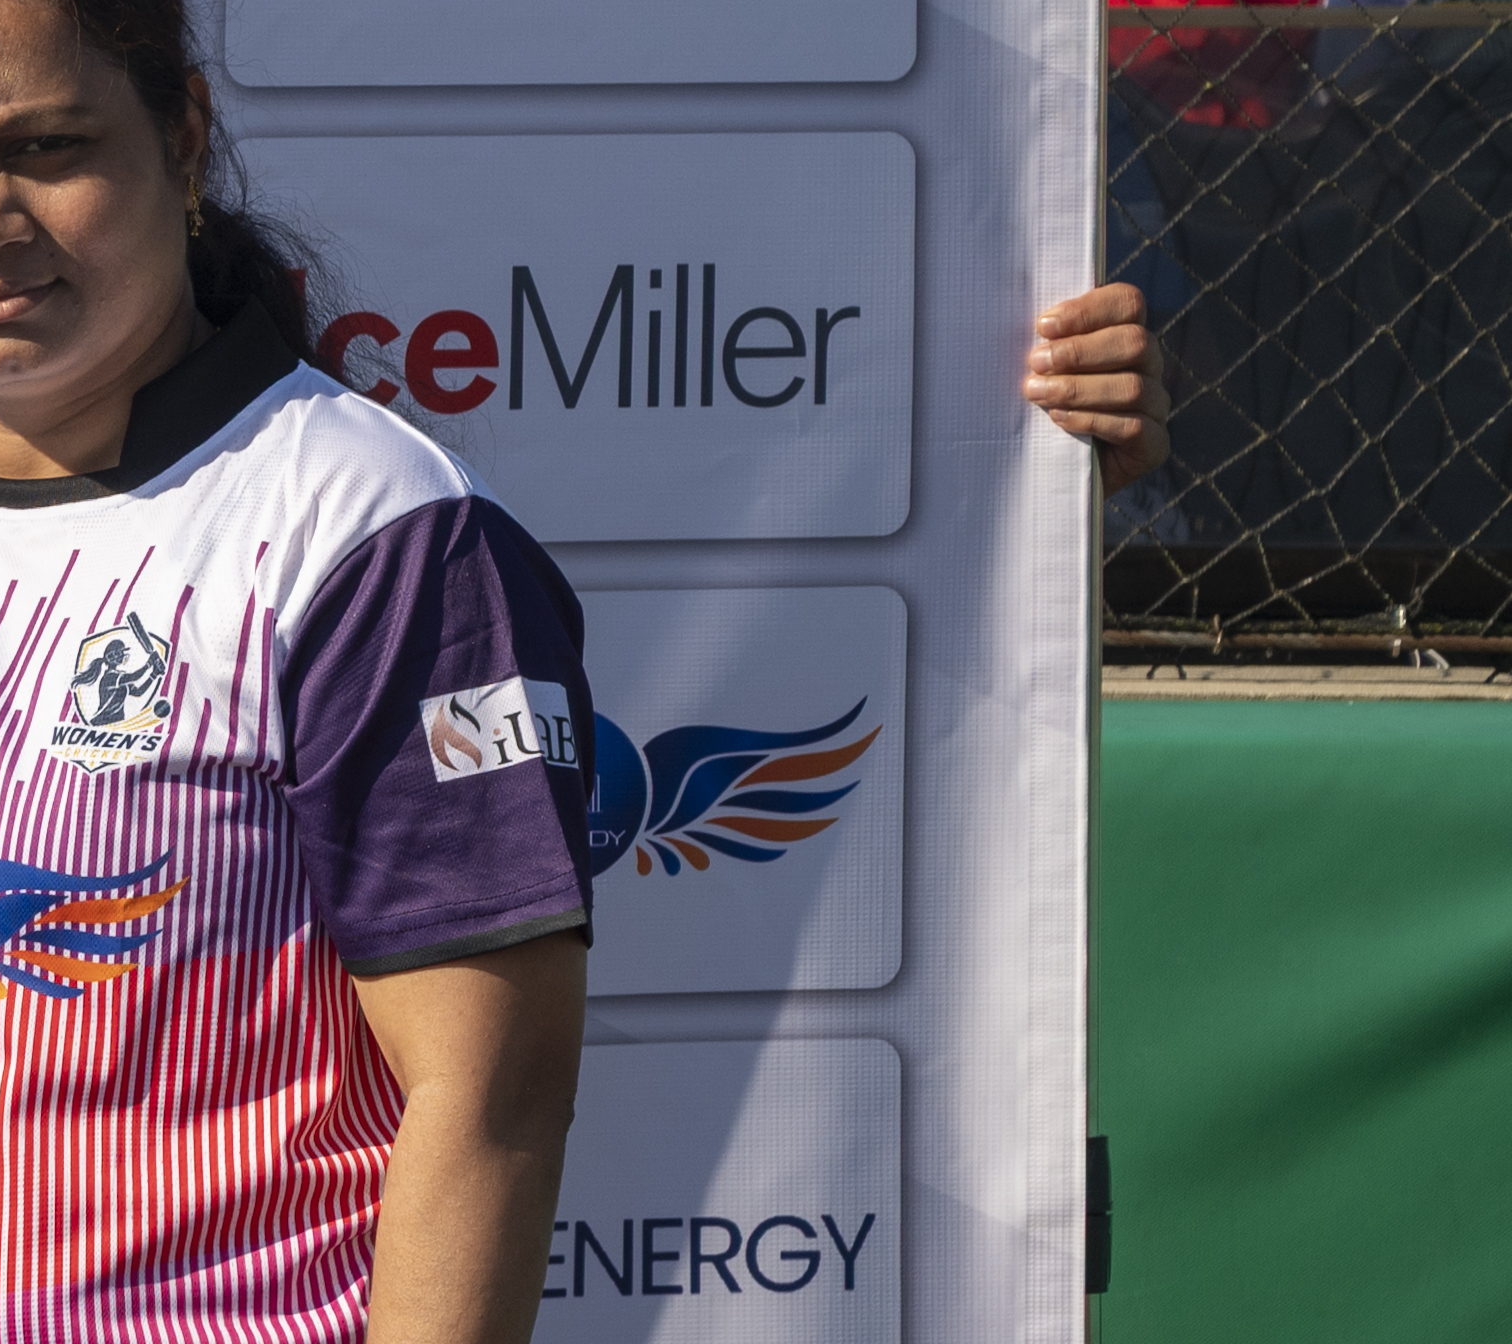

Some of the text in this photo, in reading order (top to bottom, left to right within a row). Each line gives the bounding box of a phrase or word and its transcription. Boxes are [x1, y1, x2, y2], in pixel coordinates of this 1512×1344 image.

[289, 263, 861, 416] ceMiller
[51, 726, 162, 752] WOMEN'S
[64, 747, 132, 760] CRICKET
